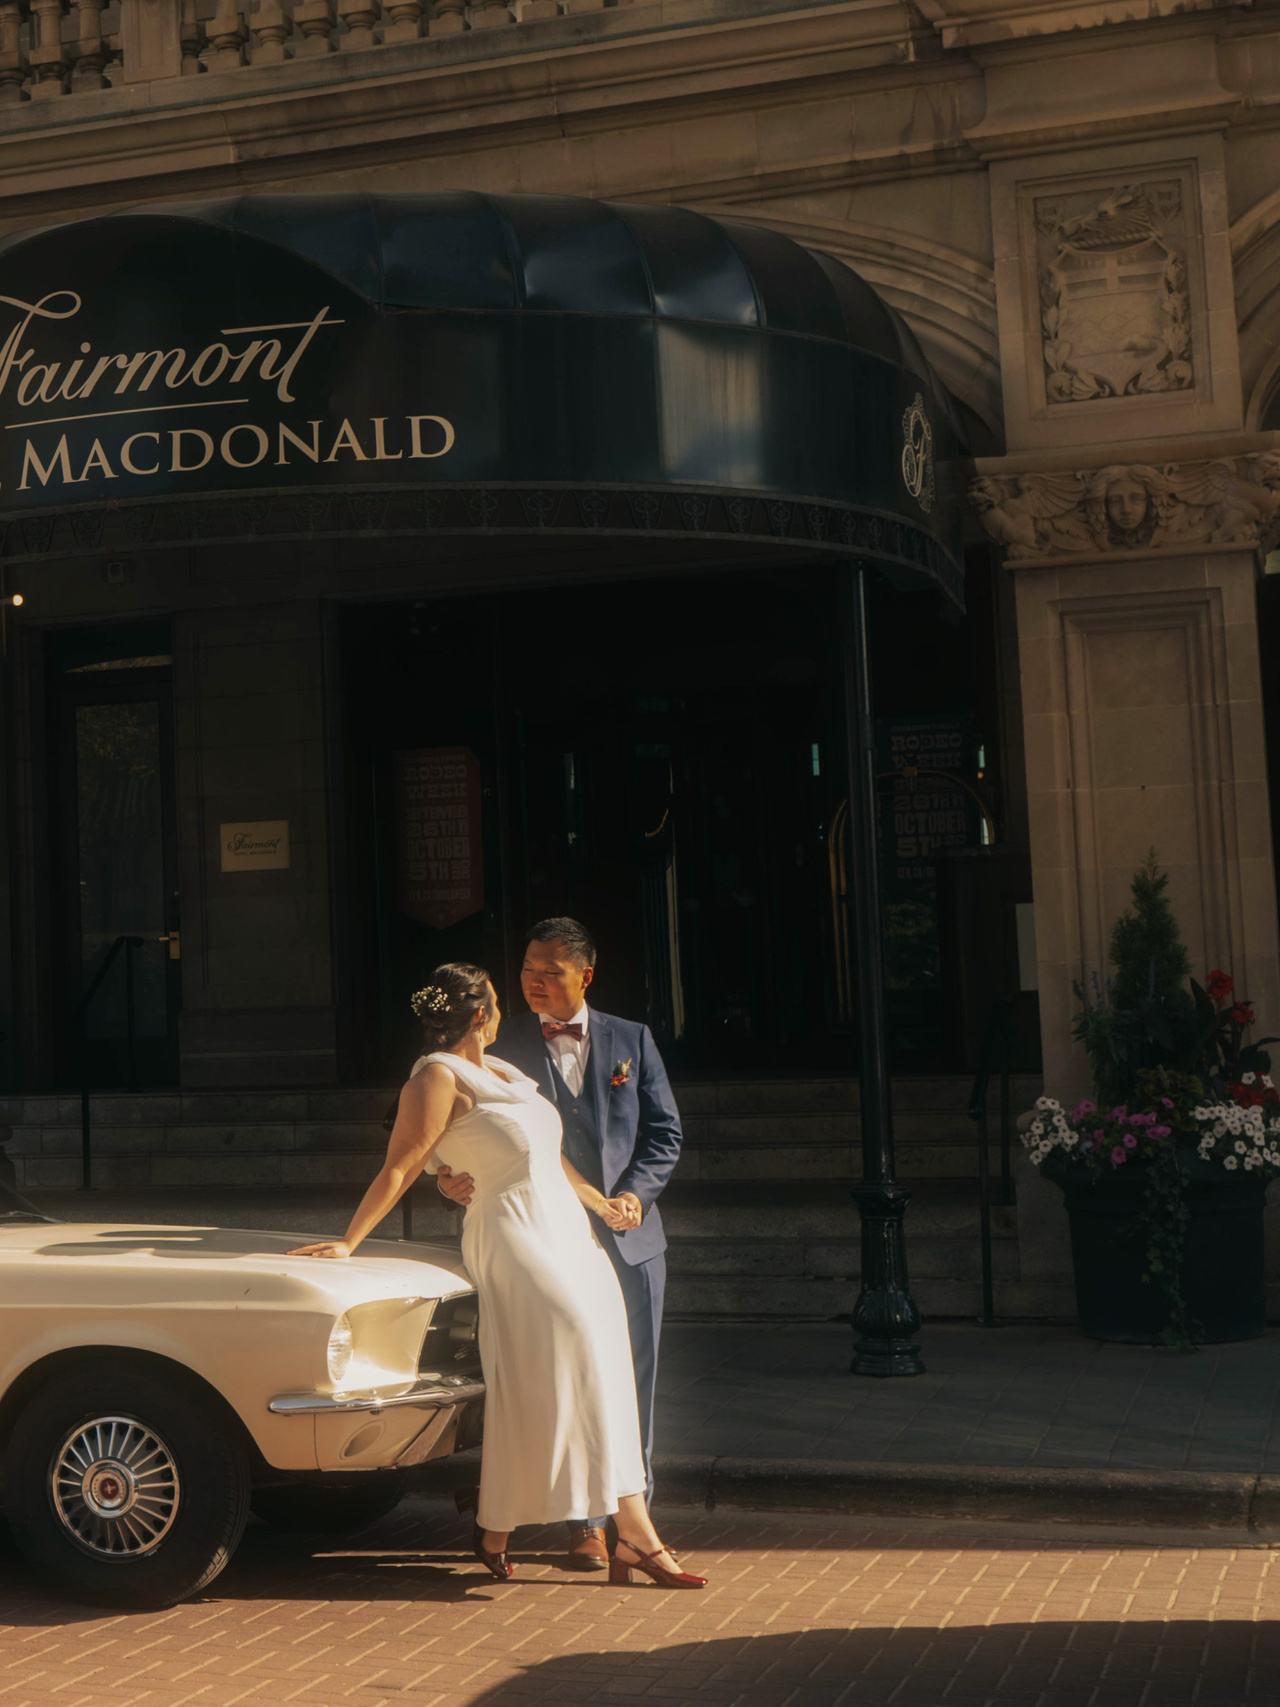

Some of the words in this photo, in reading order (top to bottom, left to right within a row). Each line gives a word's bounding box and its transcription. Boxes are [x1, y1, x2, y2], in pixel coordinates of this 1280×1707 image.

[16, 415, 456, 491] MACDONALD
[891, 732, 963, 752] RODEO
[404, 764, 468, 782] RODEO
[406, 782, 467, 800] WEEK
[406, 821, 456, 837] 26TH
[895, 810, 966, 835] OCTOBER
[227, 832, 281, 852] Fairmont
[407, 837, 471, 860] OCTOBER
[408, 860, 449, 881] 5TH
